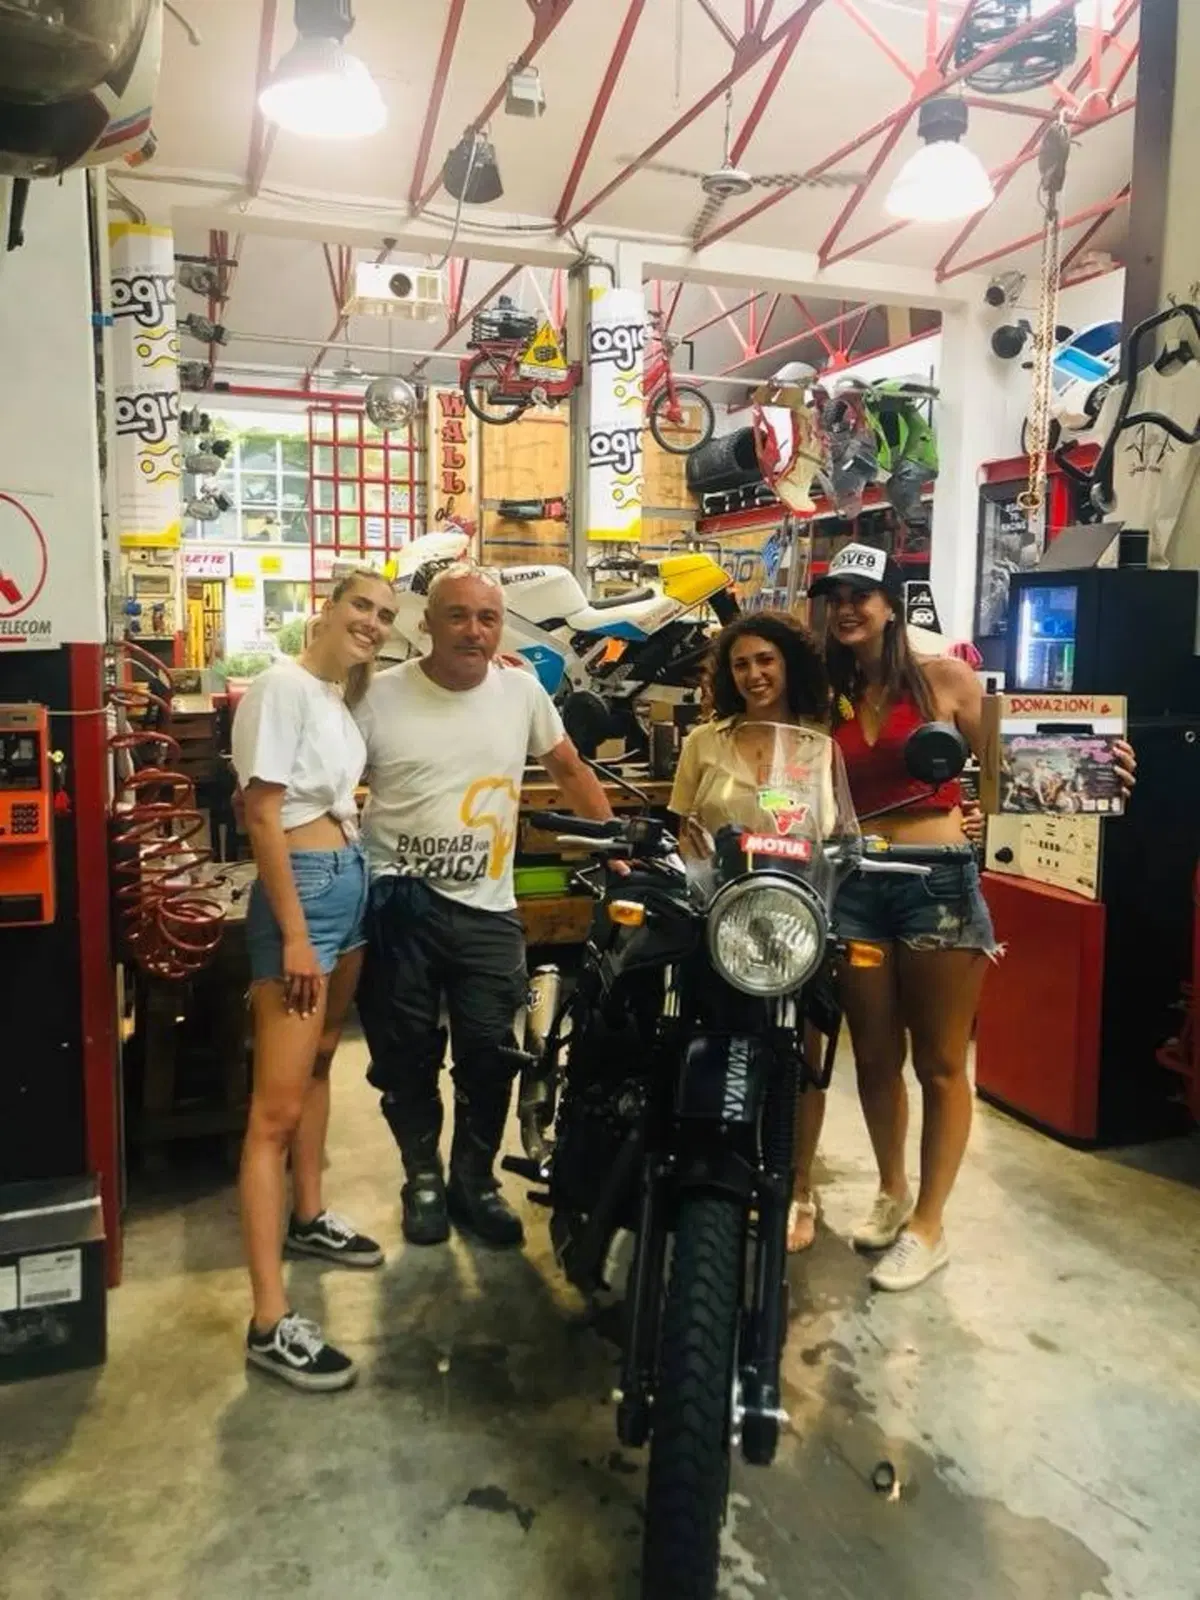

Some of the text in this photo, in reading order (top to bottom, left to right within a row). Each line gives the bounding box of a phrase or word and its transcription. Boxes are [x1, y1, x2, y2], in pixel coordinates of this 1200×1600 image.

[436, 393, 467, 495] WALL
[397, 833, 473, 856] BAOBAB
[745, 836, 808, 858] MOTUL
